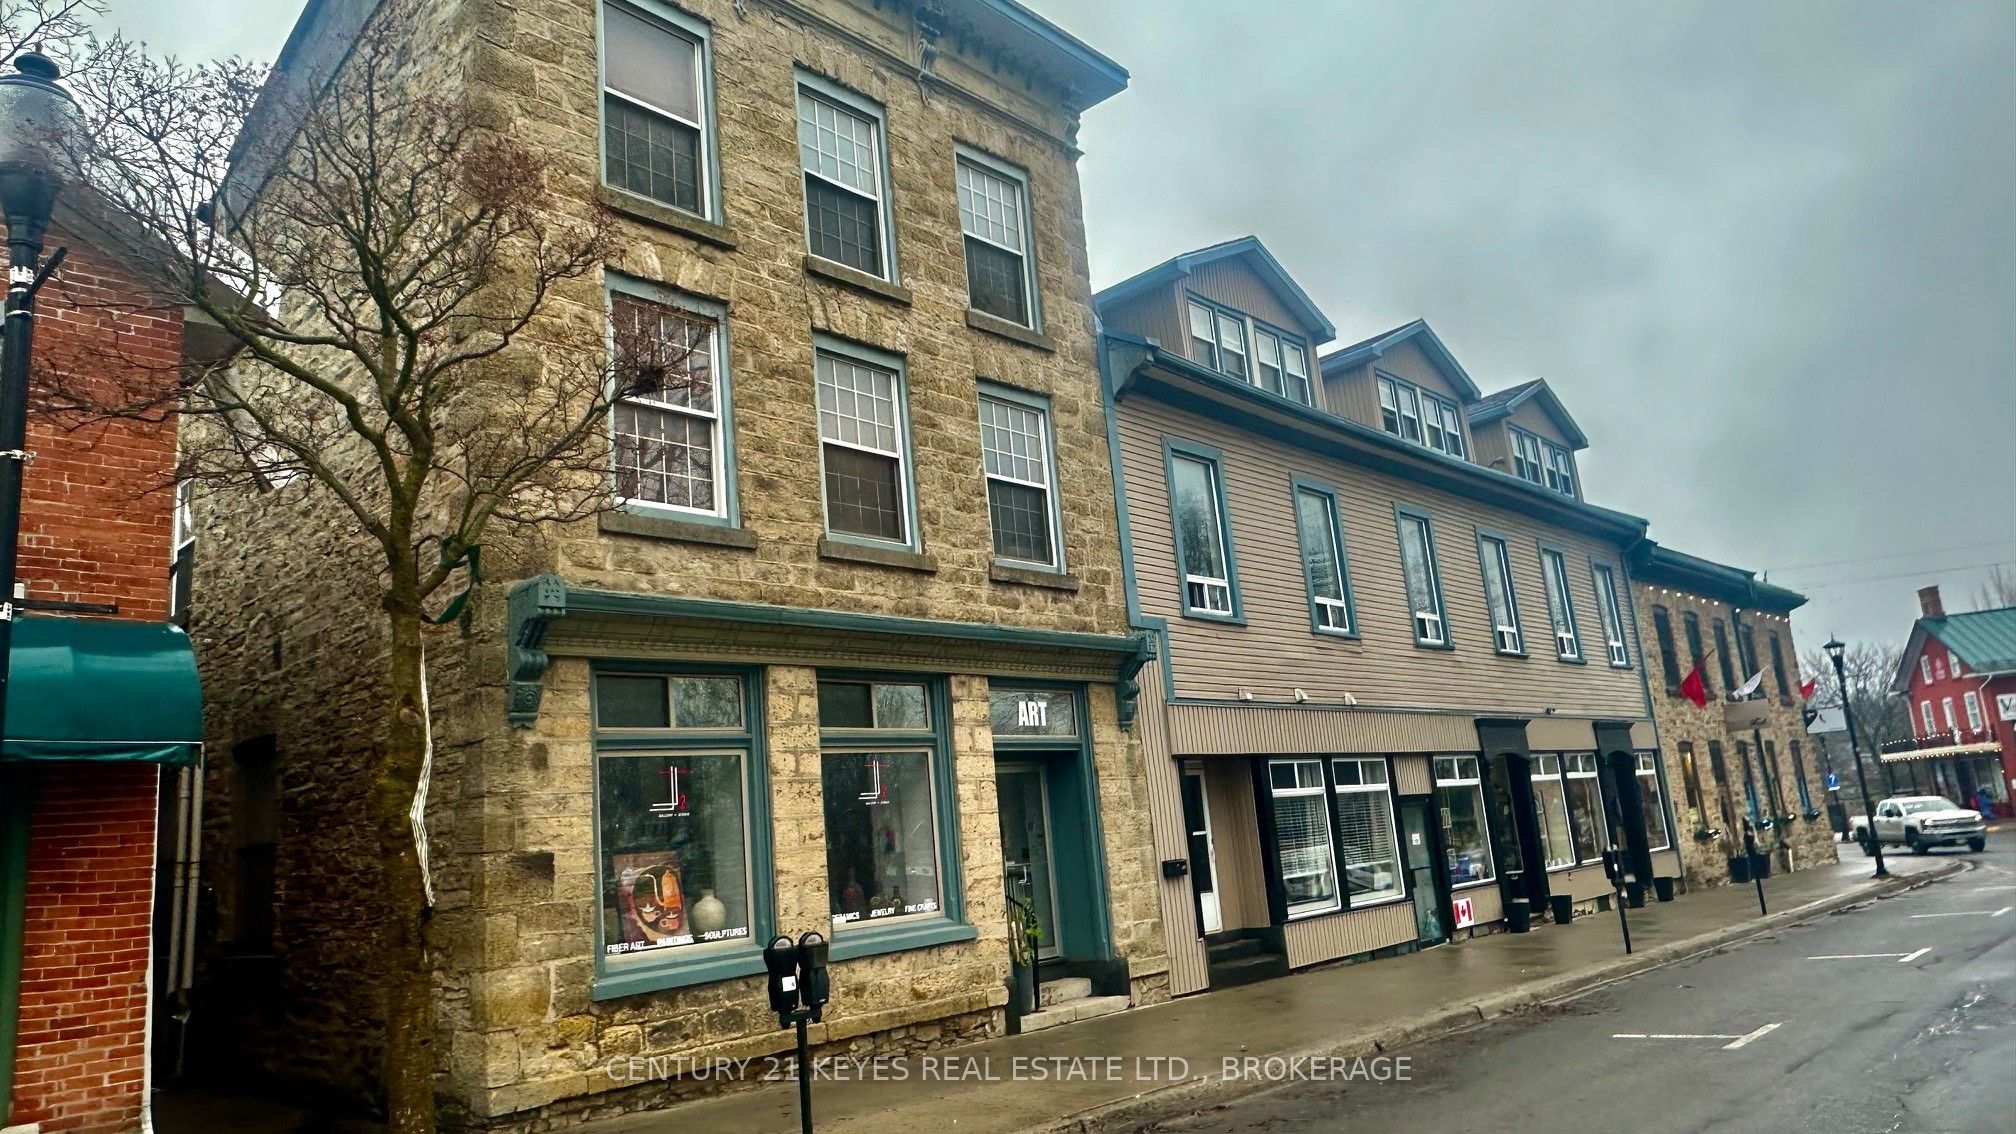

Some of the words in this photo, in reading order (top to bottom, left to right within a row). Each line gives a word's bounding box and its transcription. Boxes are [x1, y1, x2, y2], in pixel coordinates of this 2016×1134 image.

[1018, 700, 1047, 727] ART
[870, 907, 896, 918] JEWELRY
[606, 942, 629, 954] FIBER
[630, 941, 646, 951] ART
[703, 926, 748, 941] SCULPTURES
